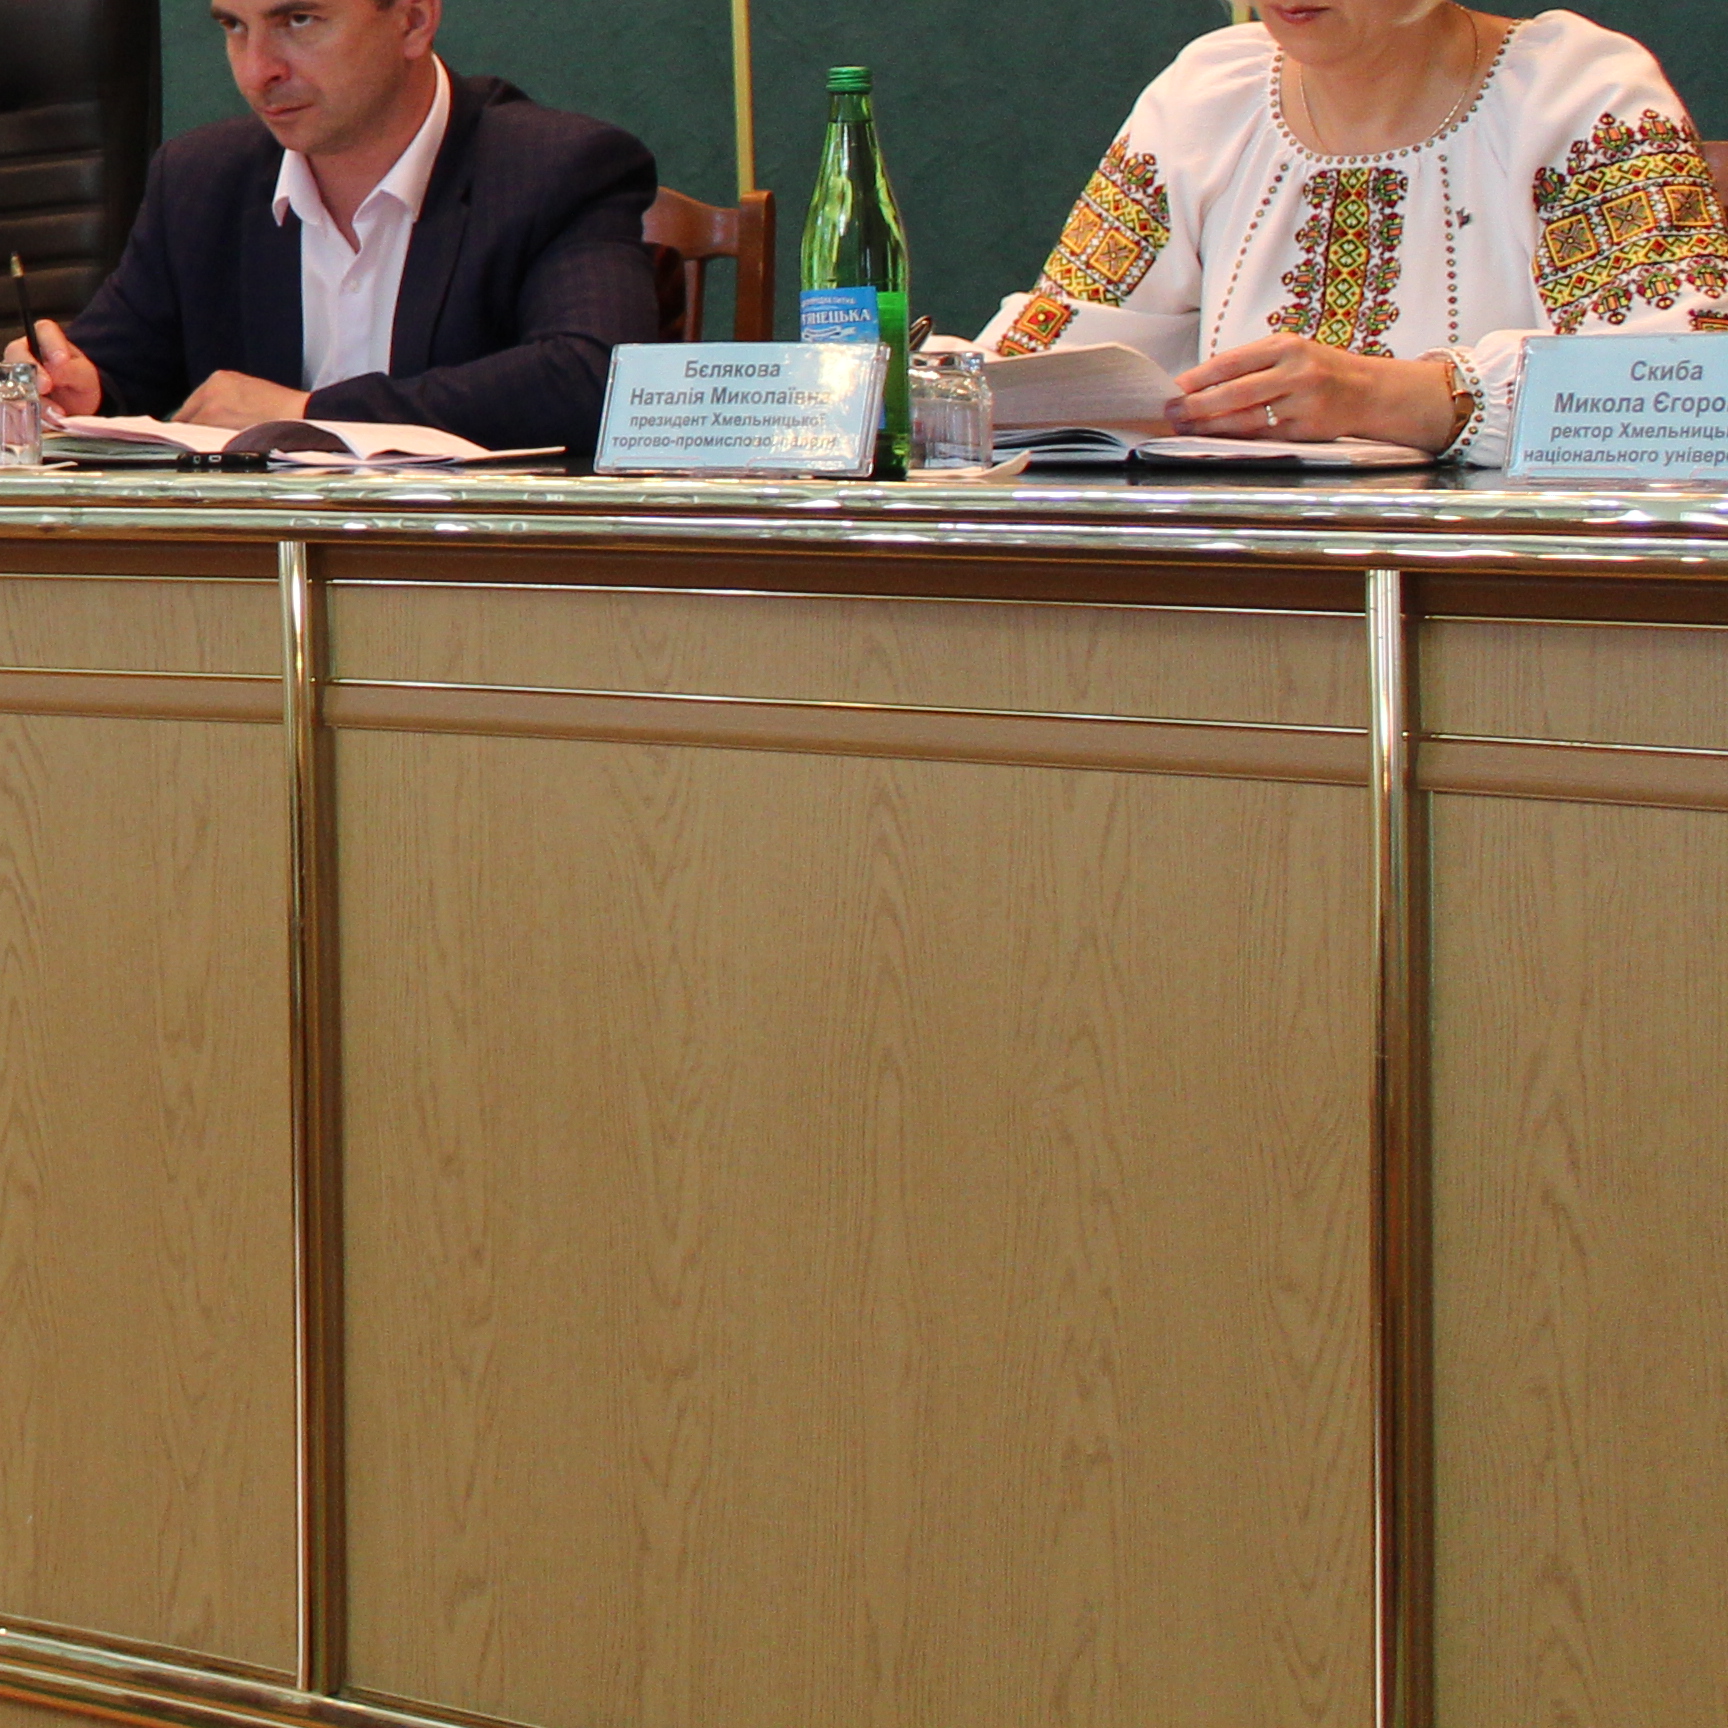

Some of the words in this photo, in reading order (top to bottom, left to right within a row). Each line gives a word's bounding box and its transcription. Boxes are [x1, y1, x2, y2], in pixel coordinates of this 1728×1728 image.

[684, 360, 781, 378] Бєлякова
[1630, 360, 1703, 381] Скиба
[630, 387, 704, 405] Наталія
[710, 386, 831, 405] Миколаївна
[1554, 392, 1645, 413] Микола
[1653, 391, 1728, 418] Єгоро
[630, 416, 706, 429] президент
[1551, 424, 1613, 442] ректор
[1617, 422, 1728, 440] Хмельниць
[1523, 447, 1659, 464] національного
